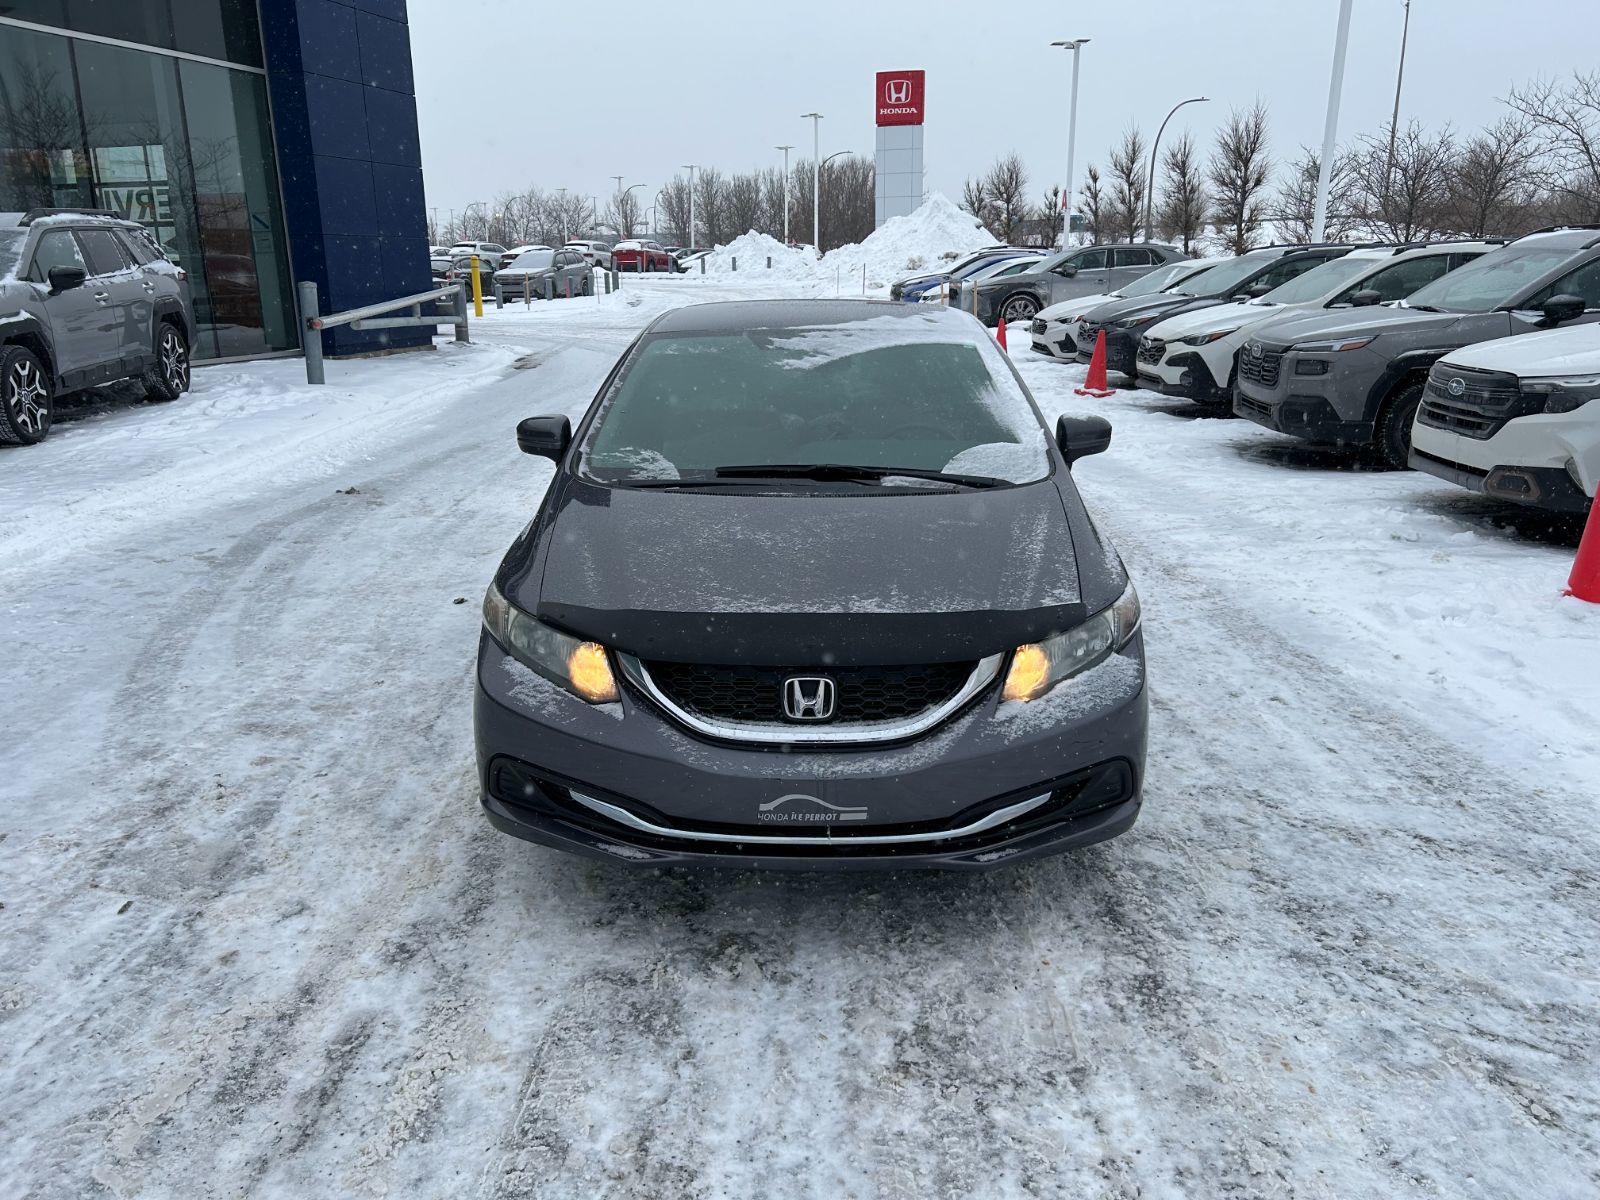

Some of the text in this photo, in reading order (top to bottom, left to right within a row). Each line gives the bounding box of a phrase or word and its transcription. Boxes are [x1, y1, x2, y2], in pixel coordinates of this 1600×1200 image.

[880, 107, 918, 115] HONDA
[757, 813, 789, 821] HONDA
[804, 813, 837, 821] PERROT
